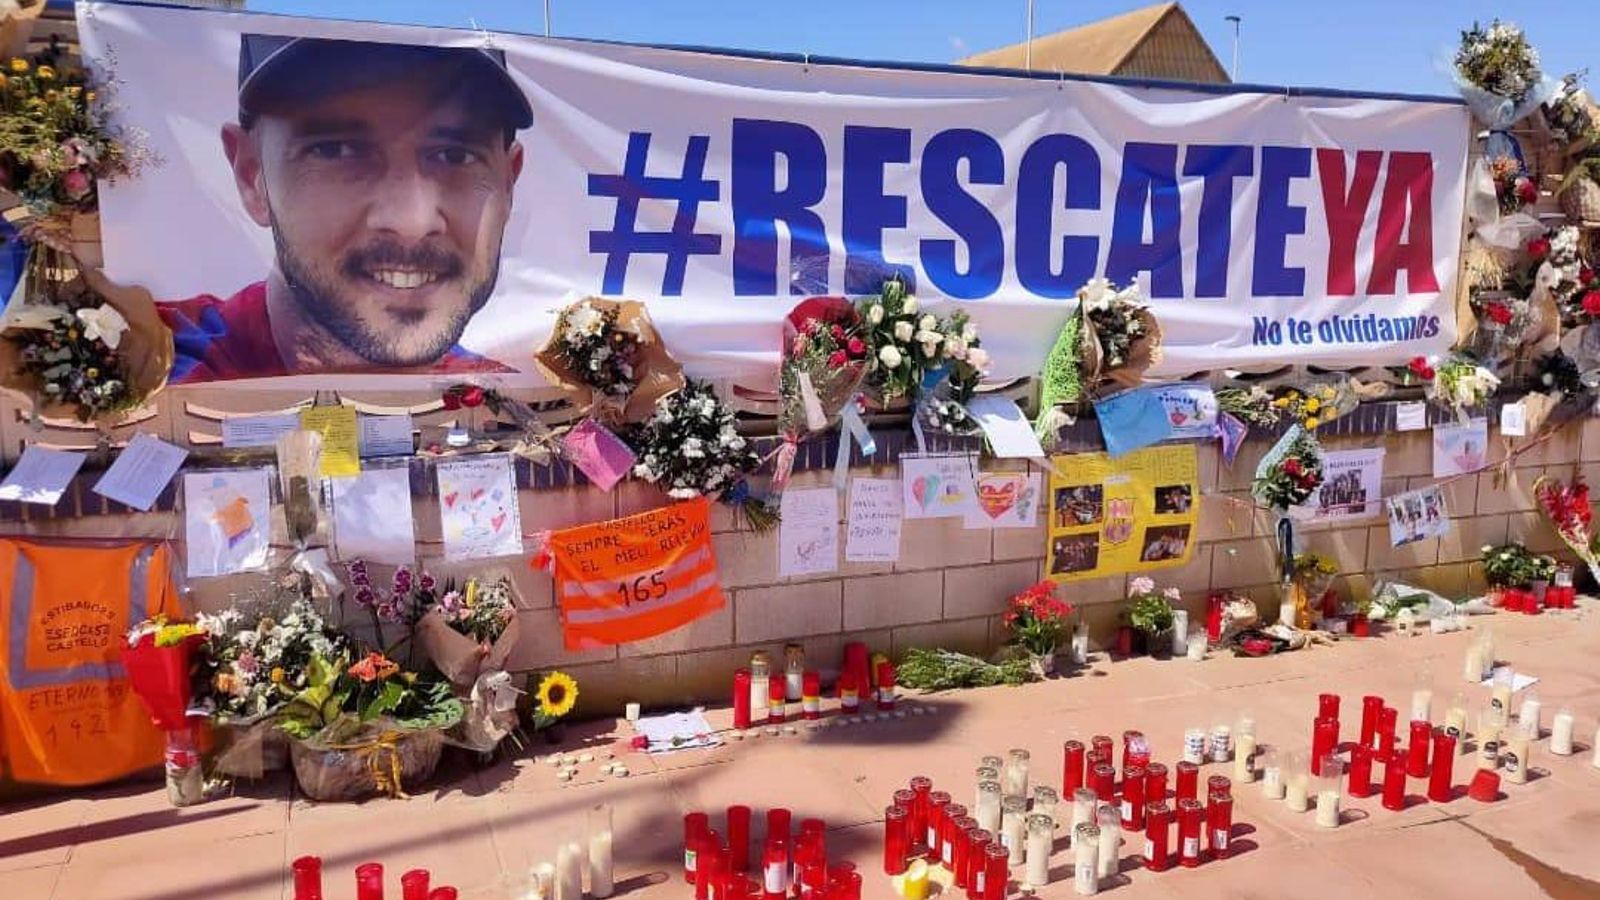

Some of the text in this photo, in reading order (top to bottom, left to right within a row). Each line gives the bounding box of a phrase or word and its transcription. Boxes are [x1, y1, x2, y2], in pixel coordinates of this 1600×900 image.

[588, 117, 1439, 299] #RESCATEYA
[1253, 313, 1440, 345] No te olvidamos
[566, 535, 622, 557] SEMPRE
[580, 560, 600, 573] EL
[617, 569, 669, 608] 165
